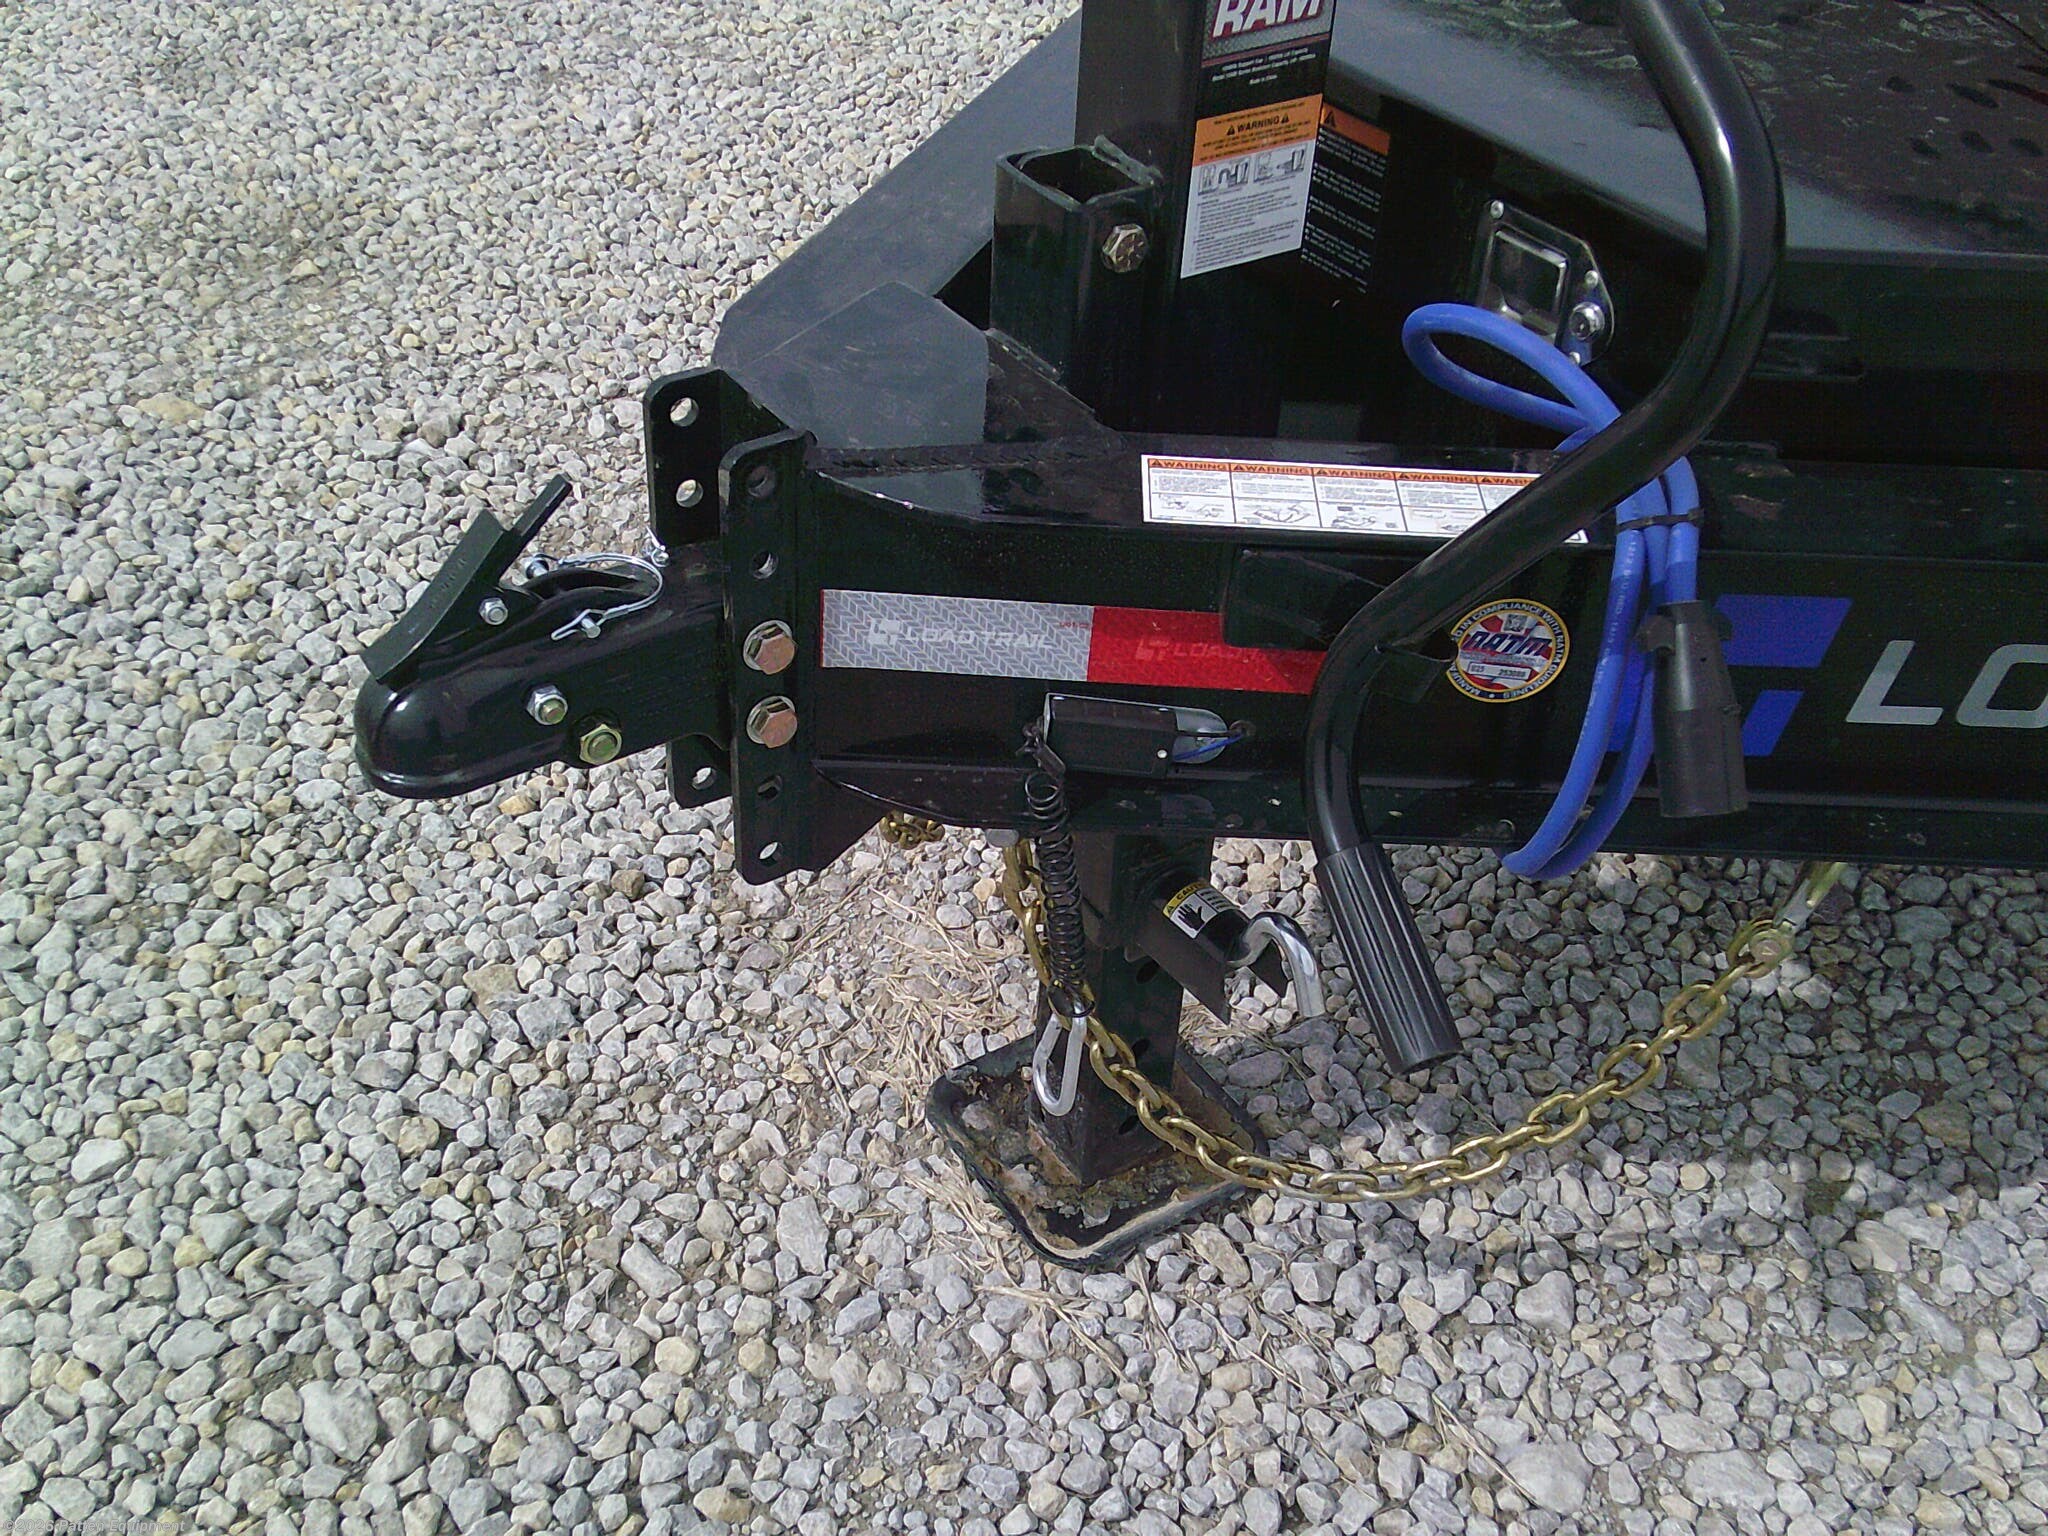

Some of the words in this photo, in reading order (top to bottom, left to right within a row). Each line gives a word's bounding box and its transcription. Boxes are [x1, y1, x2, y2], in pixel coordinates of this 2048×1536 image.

[1212, 0, 1319, 38] RAM
[1237, 115, 1280, 133] WARNING
[1164, 460, 1227, 471] WARNING
[1246, 464, 1310, 475] WARNING
[1329, 468, 1394, 479] WARNING
[1410, 472, 1475, 483] WARNING
[1493, 477, 1531, 486] WARN
[1473, 602, 1541, 619] COMPLIANCE
[1542, 612, 1561, 633] WITH
[907, 627, 975, 644] LOAD
[981, 631, 1053, 649] TRAIL
